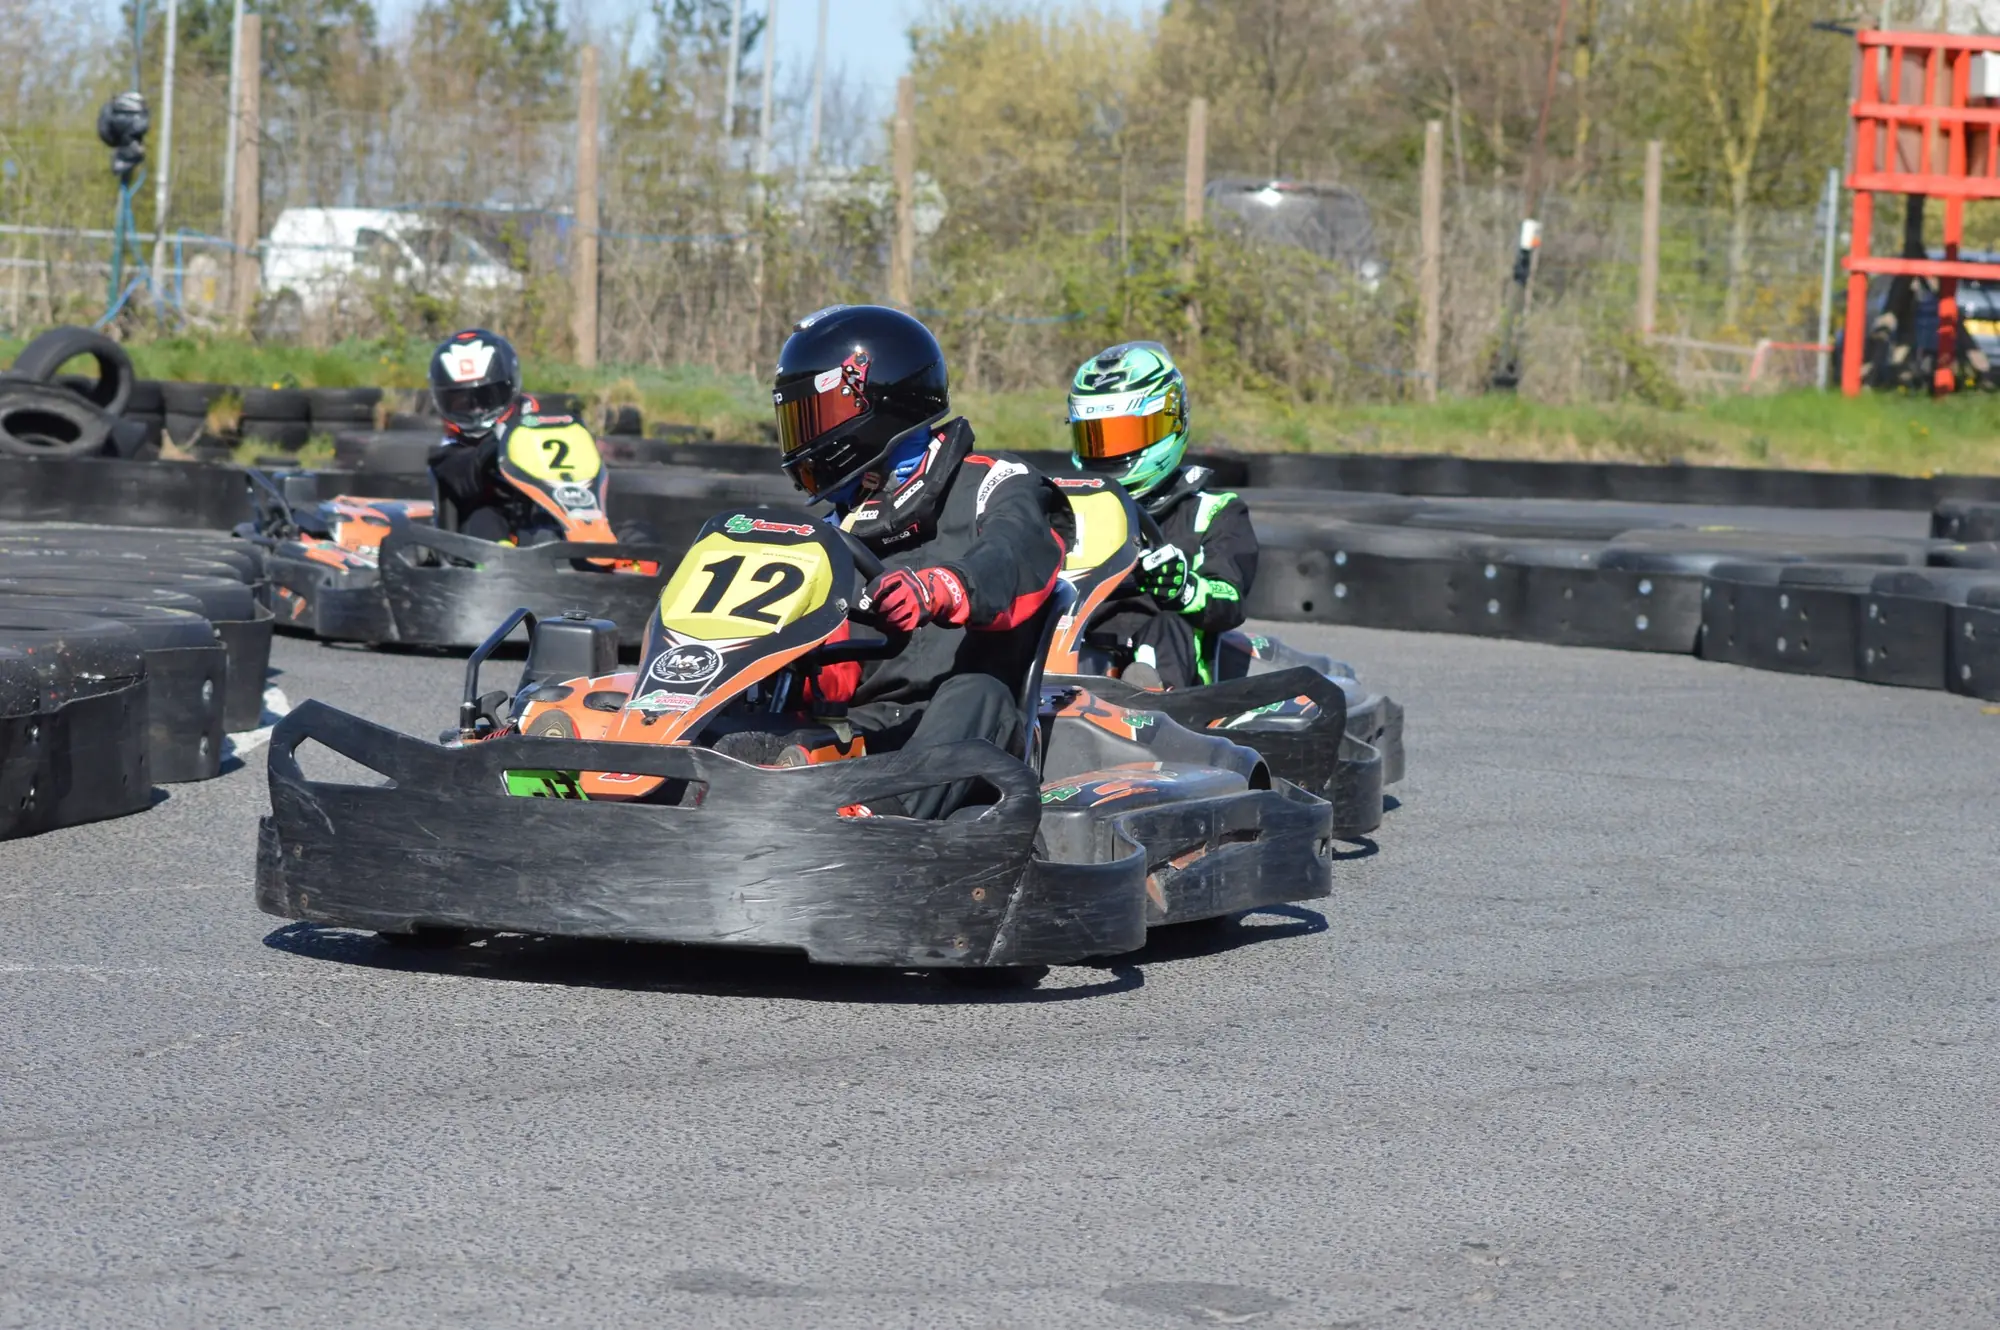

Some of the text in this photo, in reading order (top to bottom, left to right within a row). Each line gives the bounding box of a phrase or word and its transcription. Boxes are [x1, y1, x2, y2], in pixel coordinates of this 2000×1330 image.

[542, 439, 575, 470] 2
[978, 467, 1017, 502] sparco
[690, 555, 805, 625] 12
